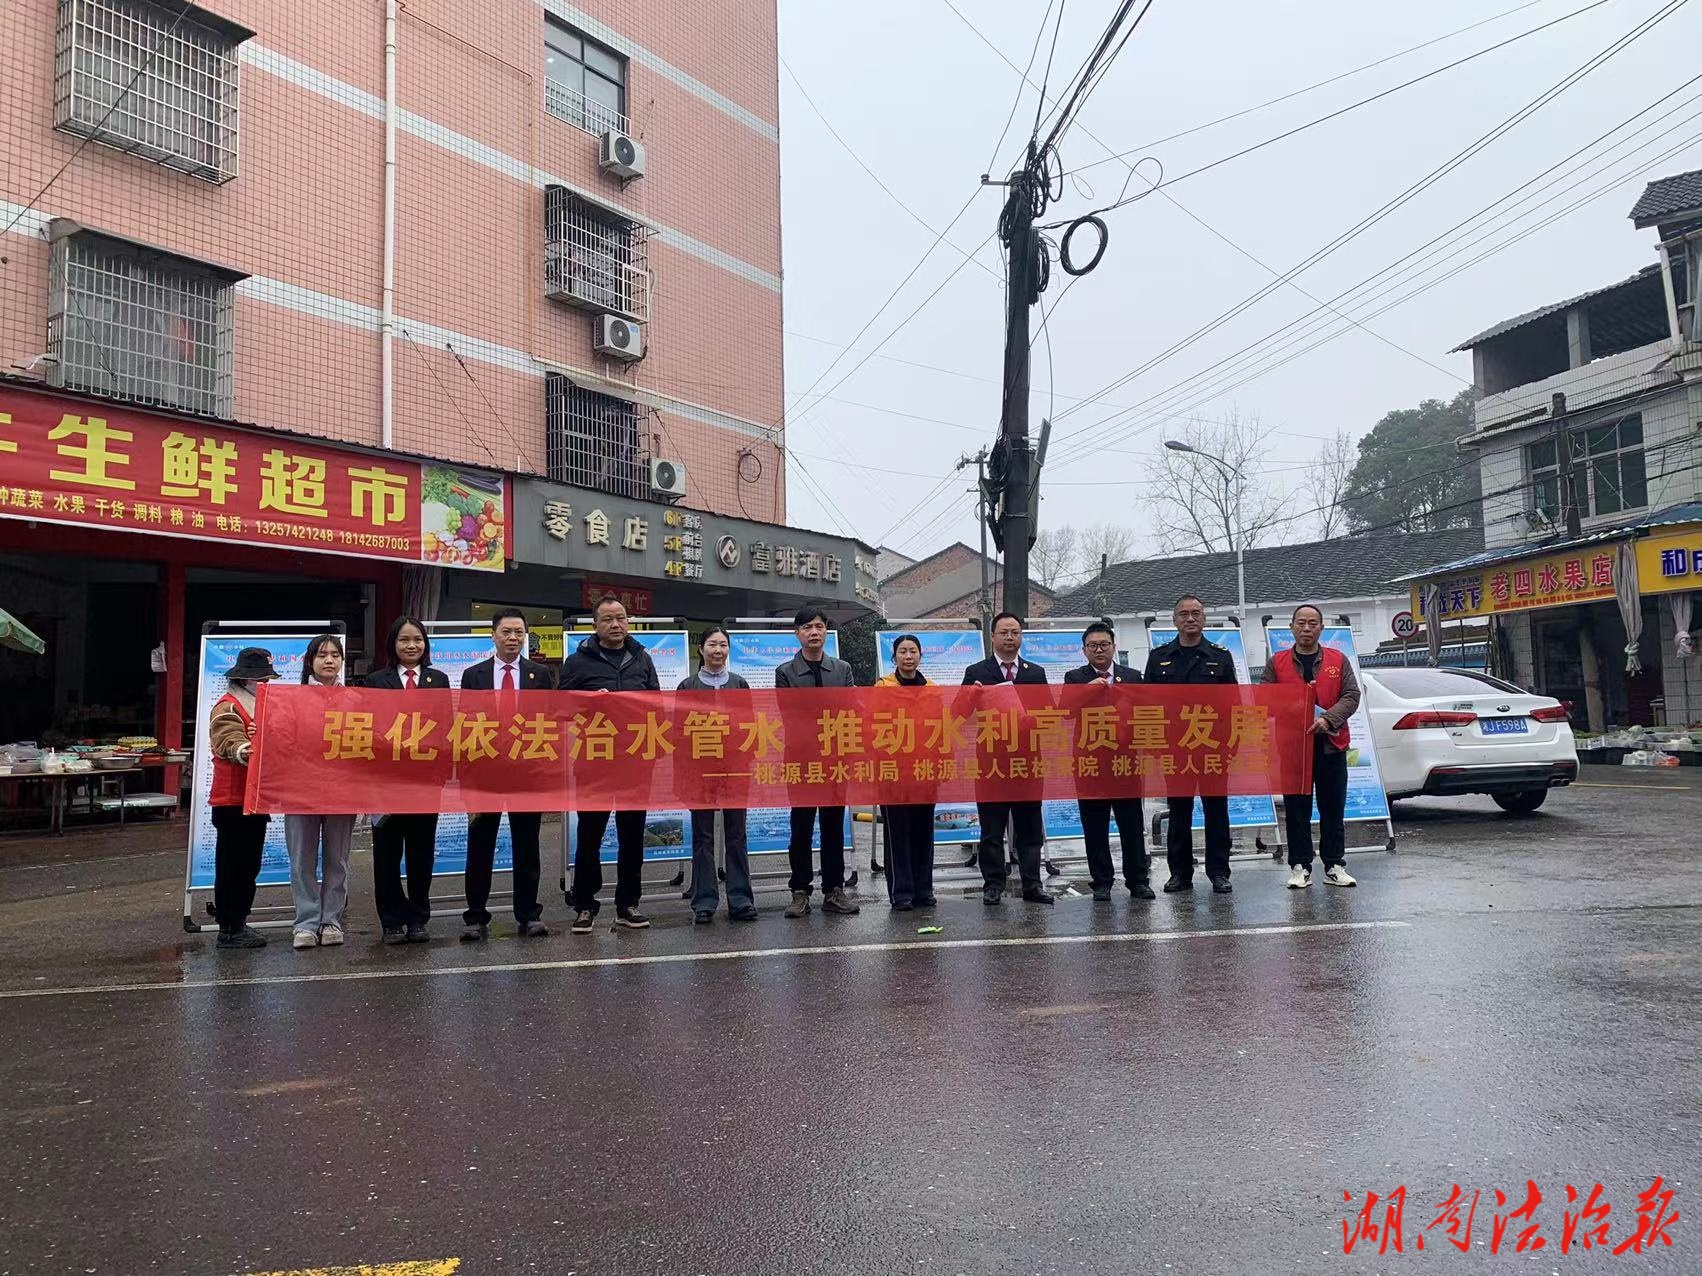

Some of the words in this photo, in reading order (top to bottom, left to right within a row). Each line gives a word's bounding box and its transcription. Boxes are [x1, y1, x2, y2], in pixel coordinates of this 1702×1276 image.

[54, 493, 86, 514] 水果
[95, 498, 125, 519] 干货
[133, 503, 163, 523] 调料
[170, 508, 184, 526] 粮
[191, 511, 205, 528] 油
[255, 520, 334, 542] 13257421248
[339, 531, 410, 551] 18142687003
[543, 500, 649, 550] 零食店
[750, 540, 842, 582] 富雅酒店
[1490, 553, 1612, 601] 老四水果店
[1420, 587, 1480, 616] 天下
[1397, 619, 1413, 632] 20
[323, 710, 785, 762] 强化依法治水管水
[818, 703, 1271, 757] 推动水利高质量发展
[1112, 753, 1268, 778] 桃源县人民
